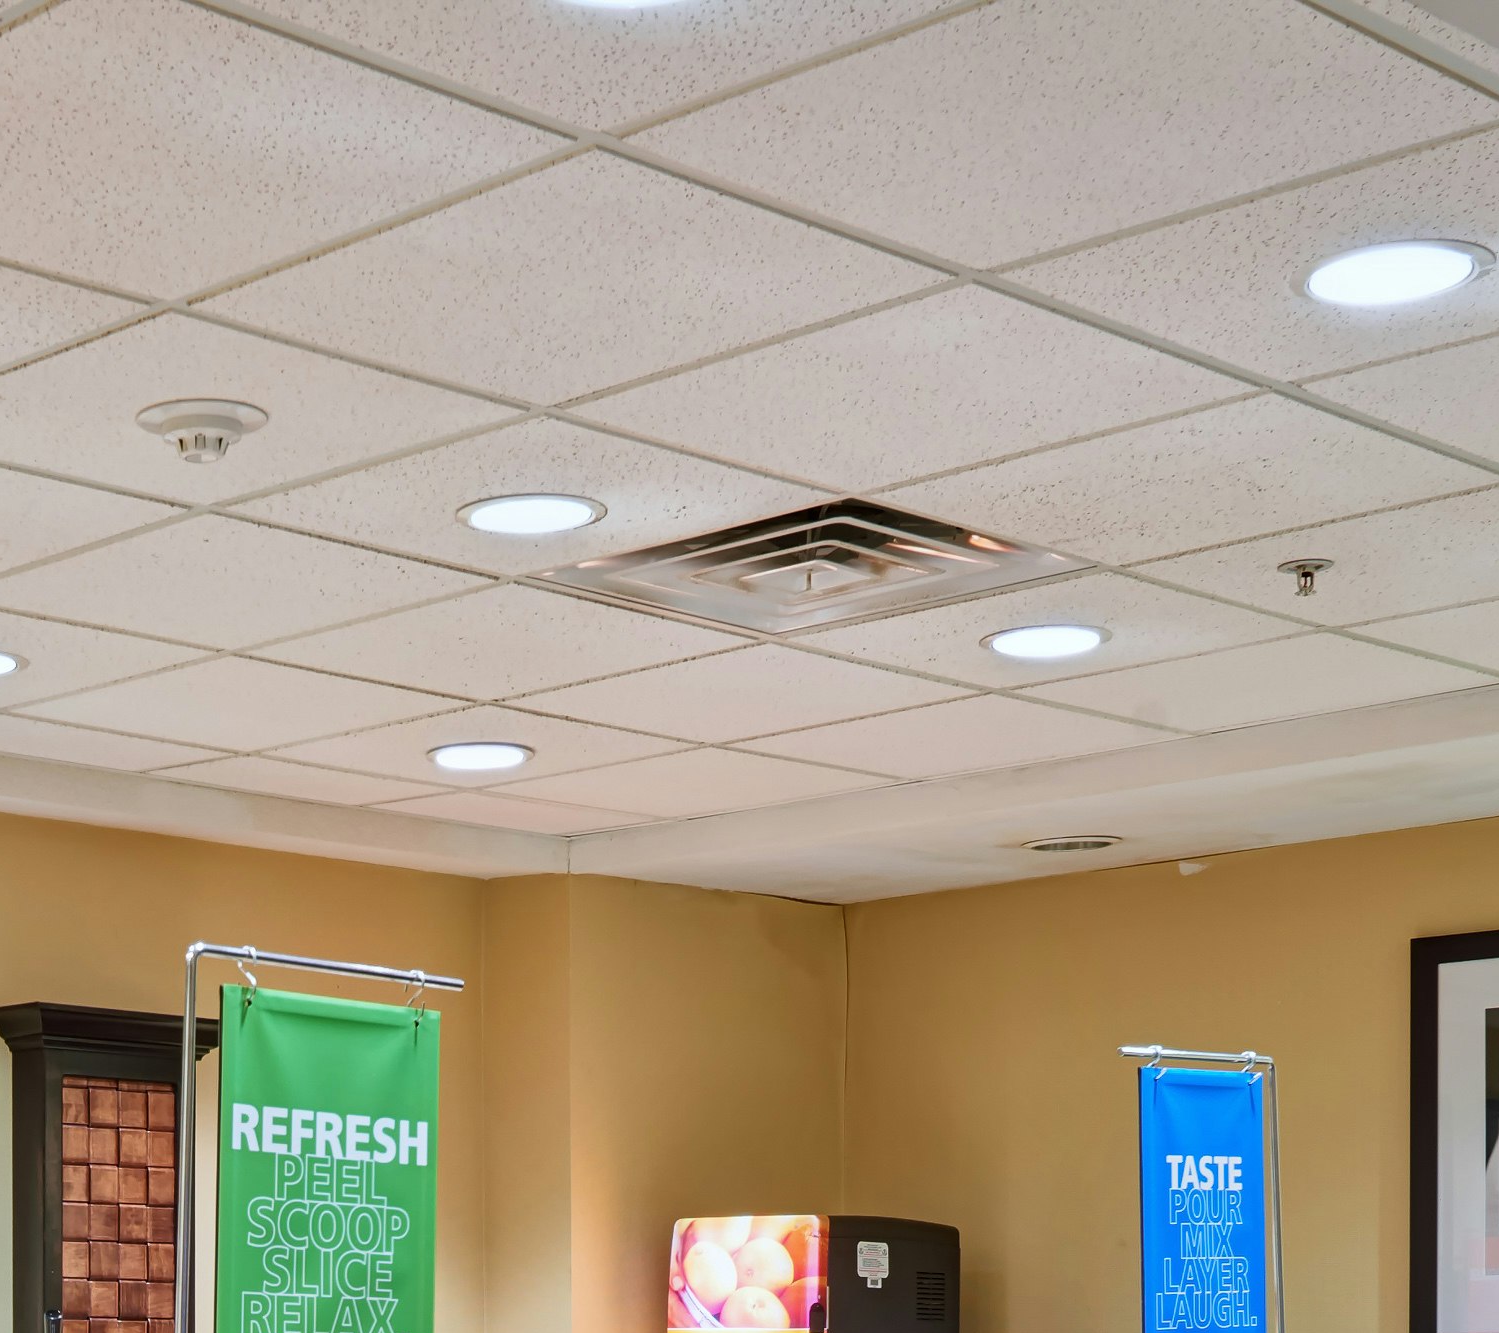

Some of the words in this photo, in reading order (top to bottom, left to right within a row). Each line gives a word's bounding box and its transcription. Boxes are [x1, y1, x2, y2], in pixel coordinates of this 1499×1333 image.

[231, 1102, 428, 1166] REFRESH
[274, 1152, 388, 1208] PEEL
[1165, 1154, 1244, 1191] TASTE
[247, 1196, 410, 1256] SCOOP
[1169, 1188, 1244, 1226] POUR
[1180, 1222, 1234, 1260] MIX
[262, 1245, 394, 1301] SLICE
[1163, 1256, 1251, 1295] LAYER
[1155, 1291, 1259, 1331] LAUGH.
